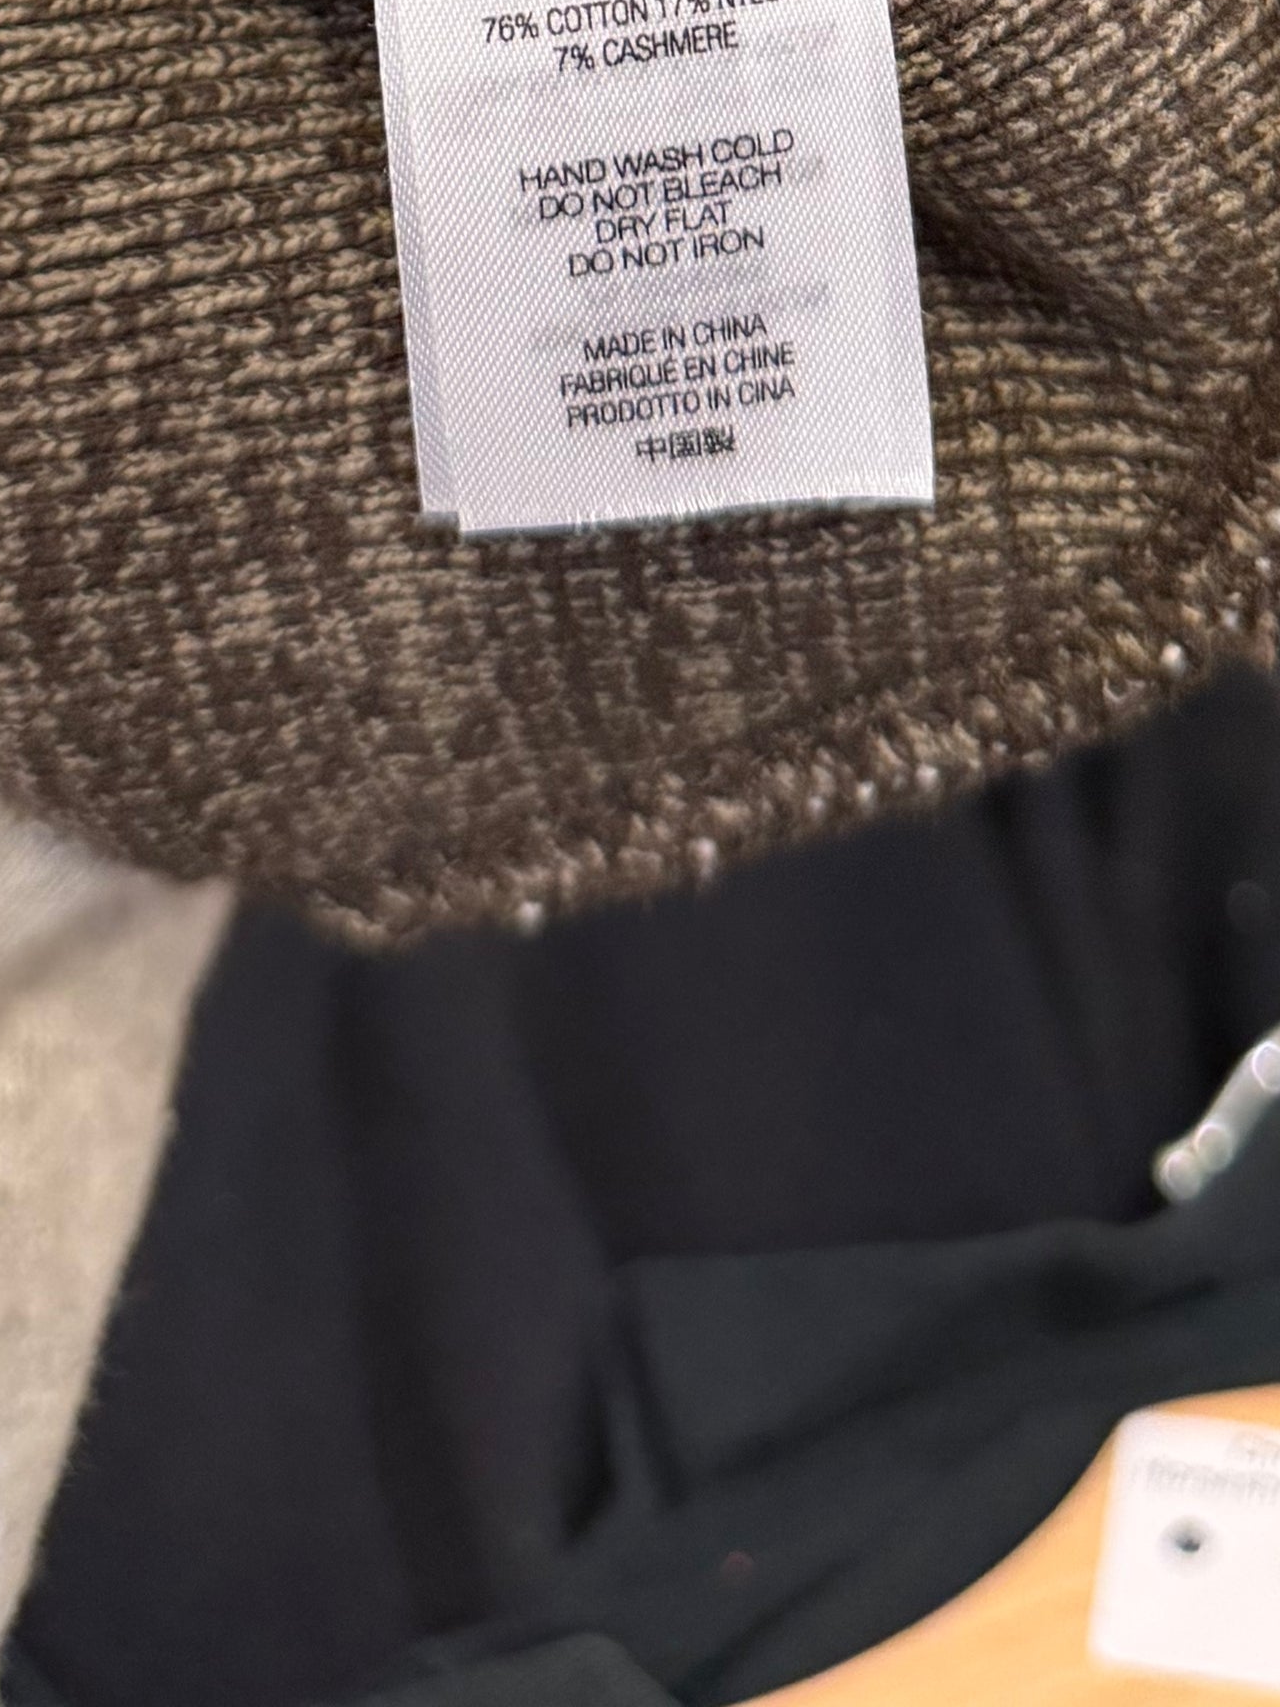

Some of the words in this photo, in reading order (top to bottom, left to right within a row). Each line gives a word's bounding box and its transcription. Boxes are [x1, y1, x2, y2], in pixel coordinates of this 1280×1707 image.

[482, 12, 539, 43] 76%
[554, 44, 595, 72] 7%
[602, 20, 739, 67] CASHMERE
[520, 158, 606, 192] HAND
[614, 144, 703, 179] WASH
[711, 128, 794, 164] COLD
[539, 193, 584, 220] DO
[593, 182, 653, 213] NOT
[664, 161, 782, 203] BLEACH
[595, 214, 655, 244] DRY
[665, 200, 732, 232] FLAT
[569, 250, 614, 277] DO
[623, 239, 684, 270] NOT
[693, 226, 764, 259] IRON
[583, 329, 656, 362] MADE
[661, 324, 685, 350] IN
[693, 313, 767, 347] CHINA
[684, 355, 716, 381] EN
[724, 341, 796, 374] CHINE
[567, 389, 700, 427] PRODOTTO
[706, 386, 731, 410] IN
[738, 375, 795, 406] CINA
